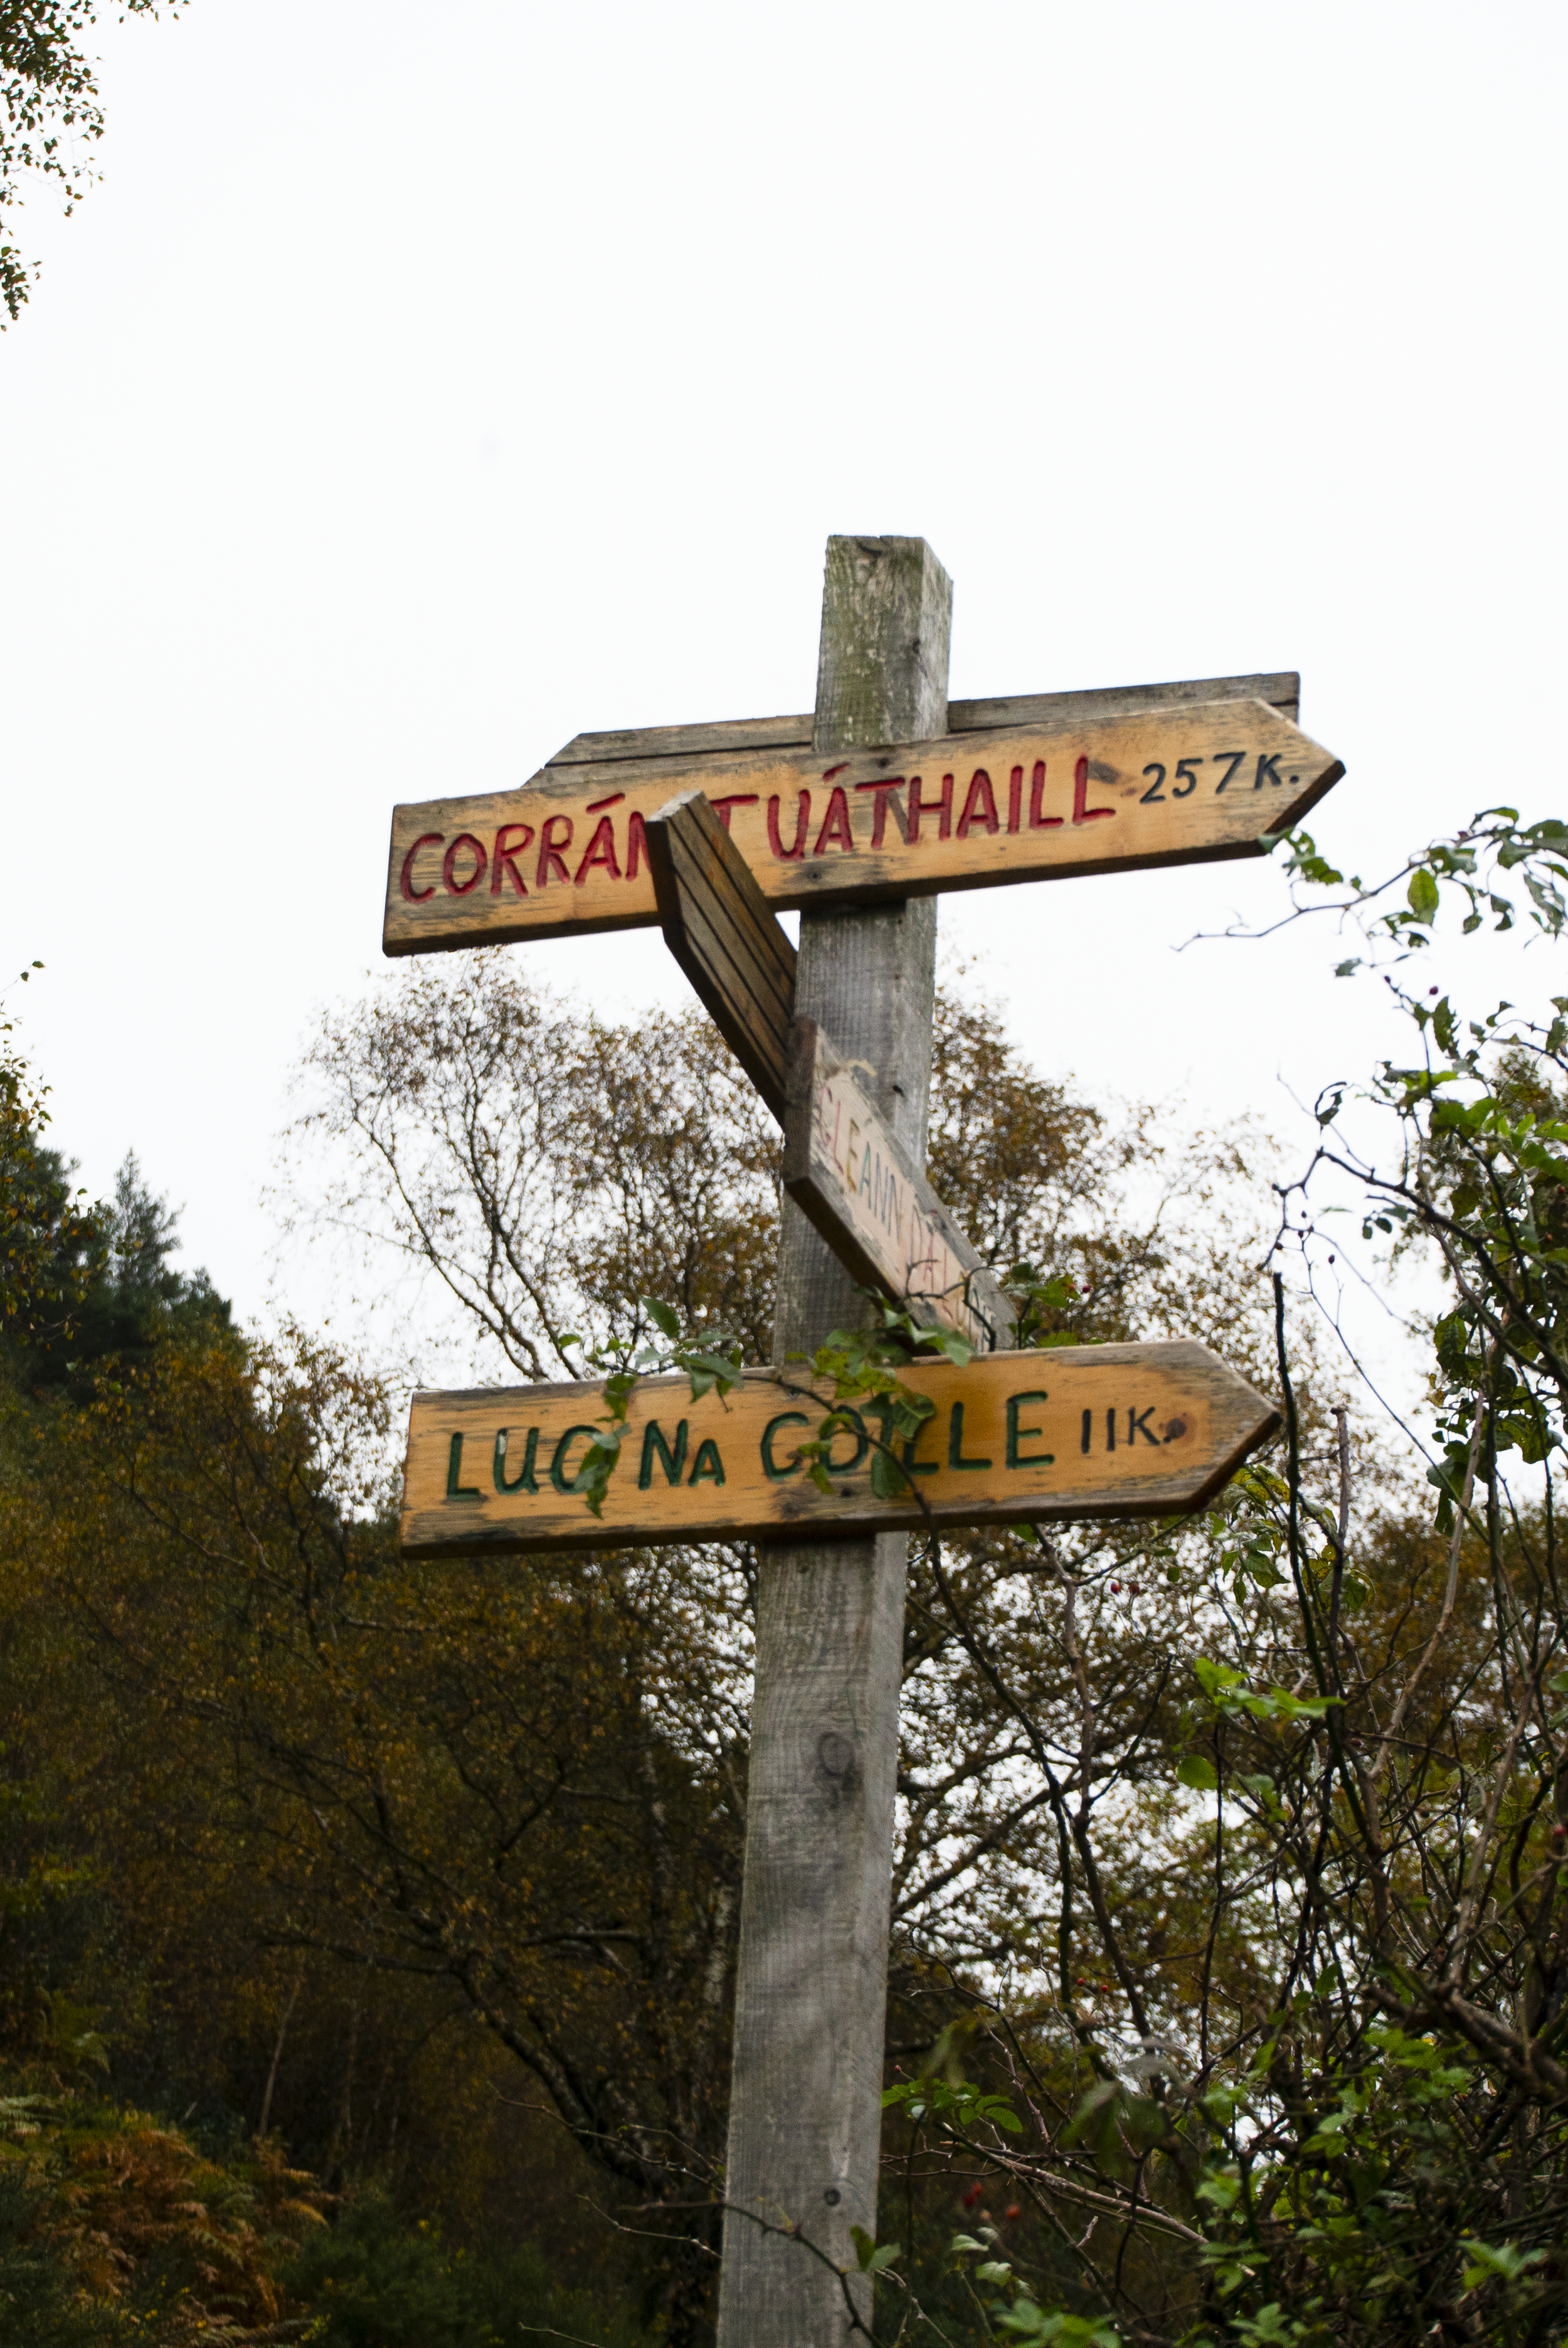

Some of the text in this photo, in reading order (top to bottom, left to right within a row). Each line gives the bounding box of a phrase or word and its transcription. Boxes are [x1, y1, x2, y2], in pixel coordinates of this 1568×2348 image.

[400, 793, 653, 904] CORRÁN
[707, 755, 1116, 862] TUÁTHAILL
[638, 1418, 726, 1490] NA
